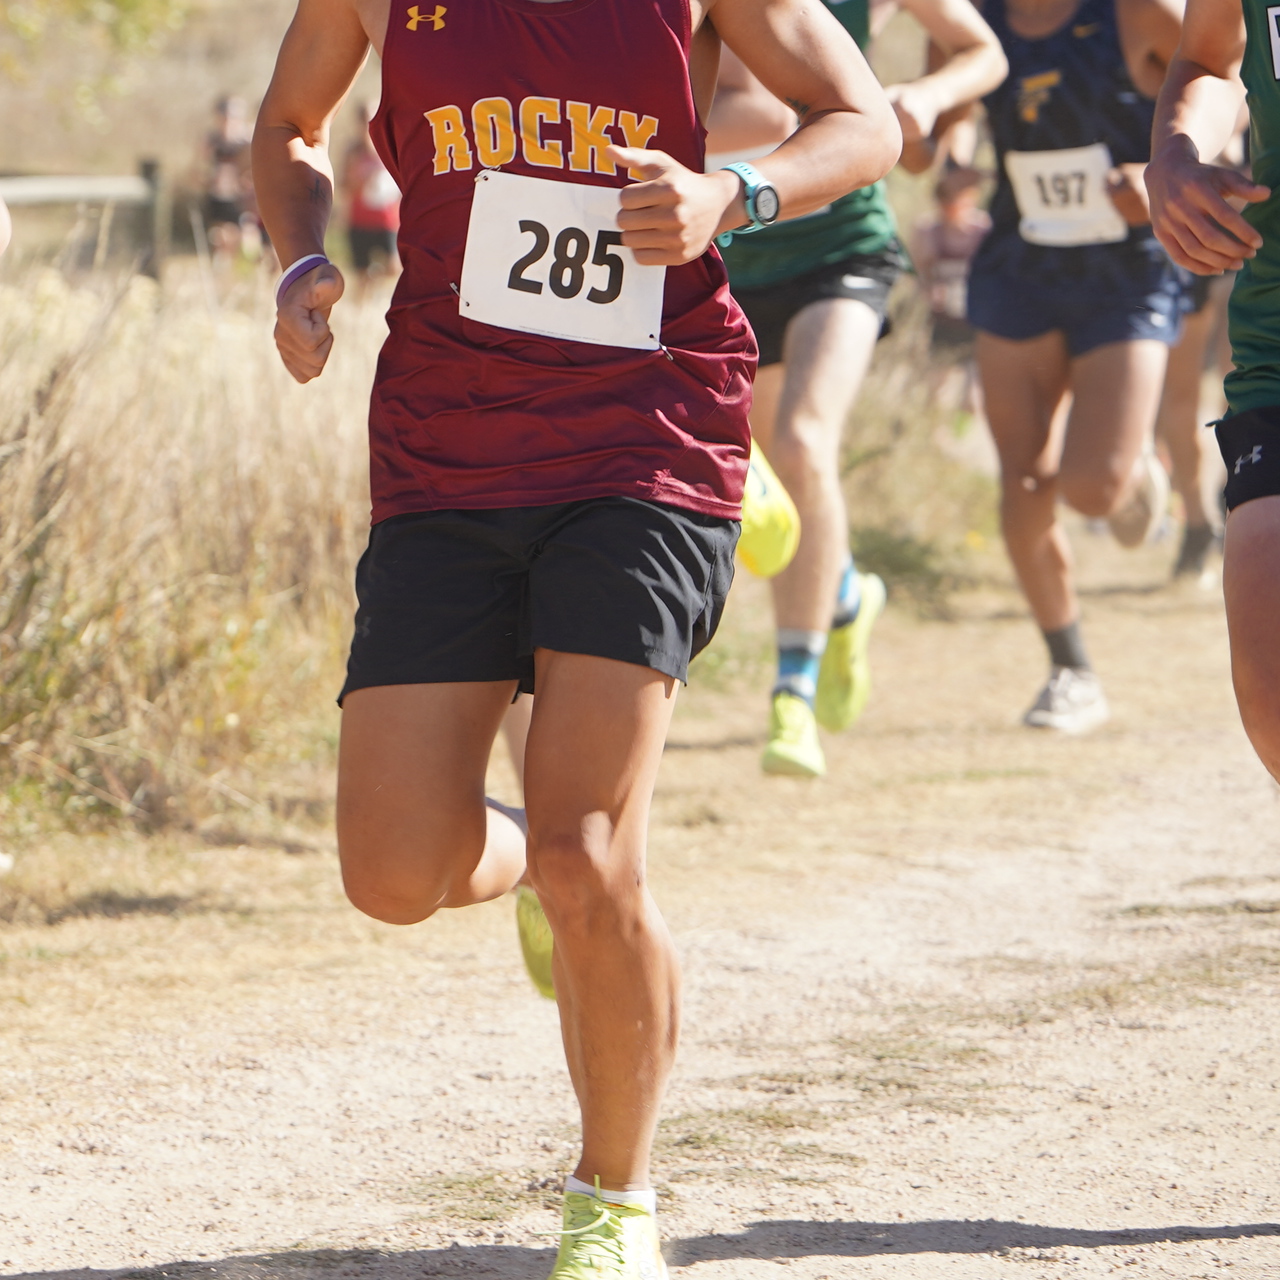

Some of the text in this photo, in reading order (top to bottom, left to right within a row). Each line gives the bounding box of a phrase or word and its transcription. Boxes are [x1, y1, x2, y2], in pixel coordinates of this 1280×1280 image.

[423, 96, 659, 182] ROCKY
[1035, 171, 1088, 207] 197
[506, 219, 625, 305] 285
